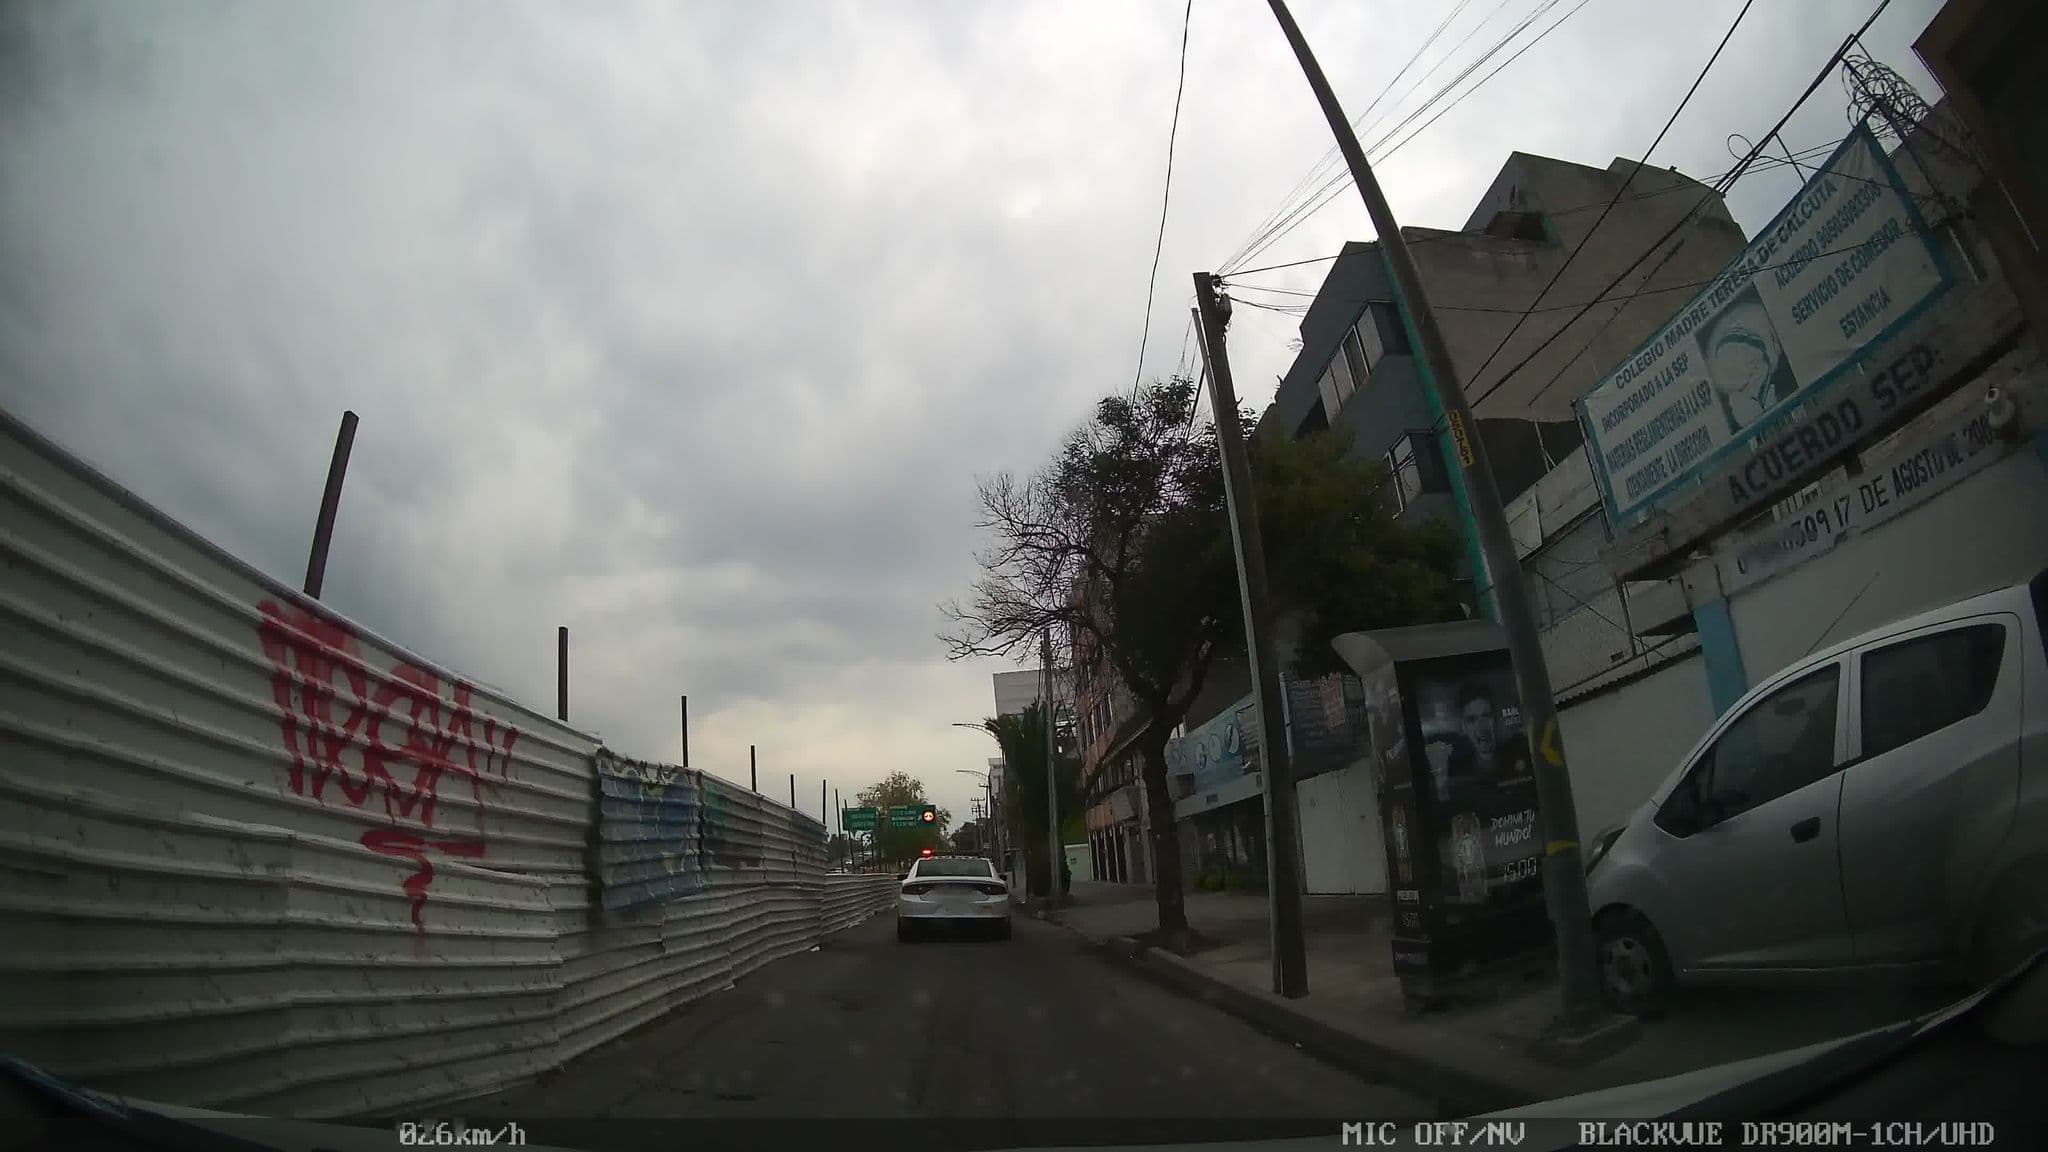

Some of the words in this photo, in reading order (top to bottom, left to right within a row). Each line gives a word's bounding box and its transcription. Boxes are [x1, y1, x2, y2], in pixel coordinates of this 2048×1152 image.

[1615, 344, 1664, 389] COLEGIO
[1664, 302, 1709, 349] MADRE
[1709, 259, 1758, 308] TERESA
[1757, 241, 1777, 265] DE
[1775, 179, 1837, 244] CALCUTA
[1791, 276, 1839, 325] SERVICIO
[1836, 260, 1854, 287] DE
[1850, 217, 1904, 274] COMEDOR
[1839, 286, 1891, 338] ESTANCIA
[1601, 381, 1657, 434] INCORPORADO
[1662, 366, 1674, 388] LA
[1671, 353, 1689, 383] SEP
[1727, 400, 1863, 504] ACUERDO
[1834, 496, 1850, 528] 17
[1859, 475, 1889, 515] DE
[1495, 824, 1532, 848] MUNDO!
